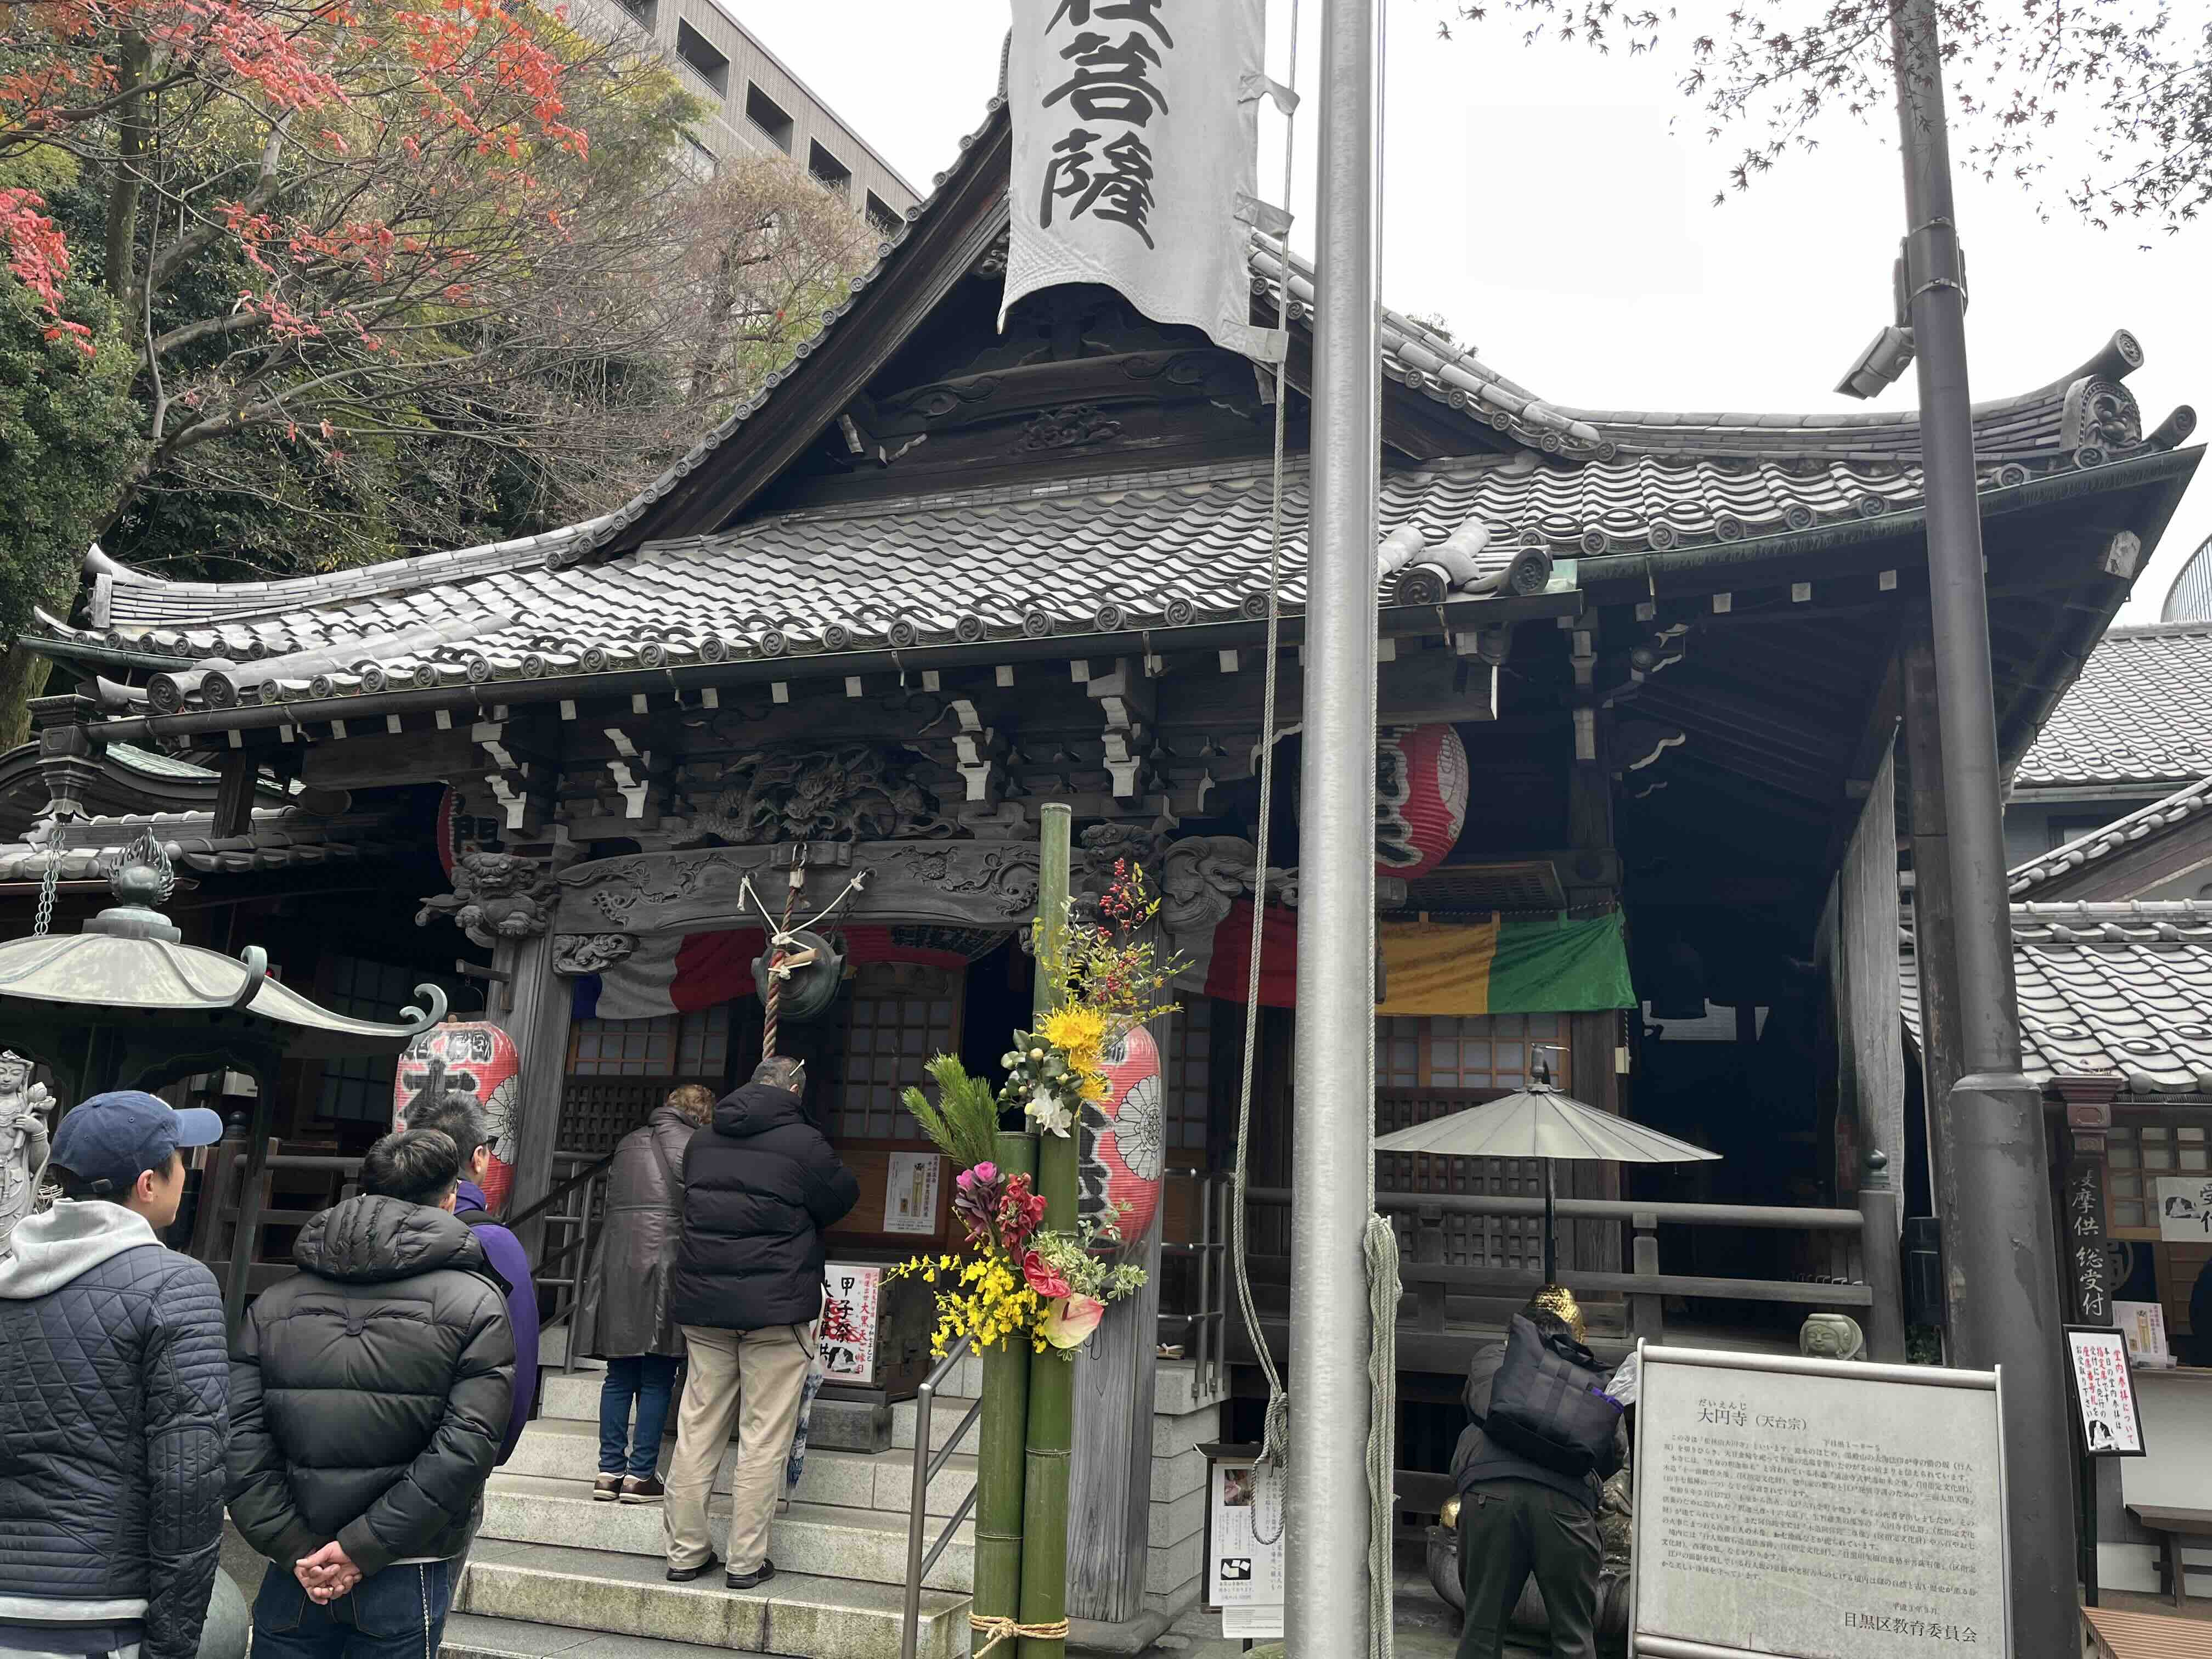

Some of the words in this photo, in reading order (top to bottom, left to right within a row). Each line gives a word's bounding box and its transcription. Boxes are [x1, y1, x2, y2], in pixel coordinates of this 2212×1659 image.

[836, 1277, 855, 1343] 甲子祭
[2076, 1245, 2103, 1316] 総受付
[1699, 1399, 1747, 1410] だいえんじ
[2090, 1346, 2107, 1418] 受付にて発行の
[2097, 1347, 2109, 1402] 指定席です
[2104, 1347, 2121, 1430] 本日の堂内参拝は
[2113, 1348, 2134, 1444] 堂内参拝について
[1697, 1408, 1747, 1427] 大円寺
[1844, 1611, 1977, 1643] 目黒区教育委員会
